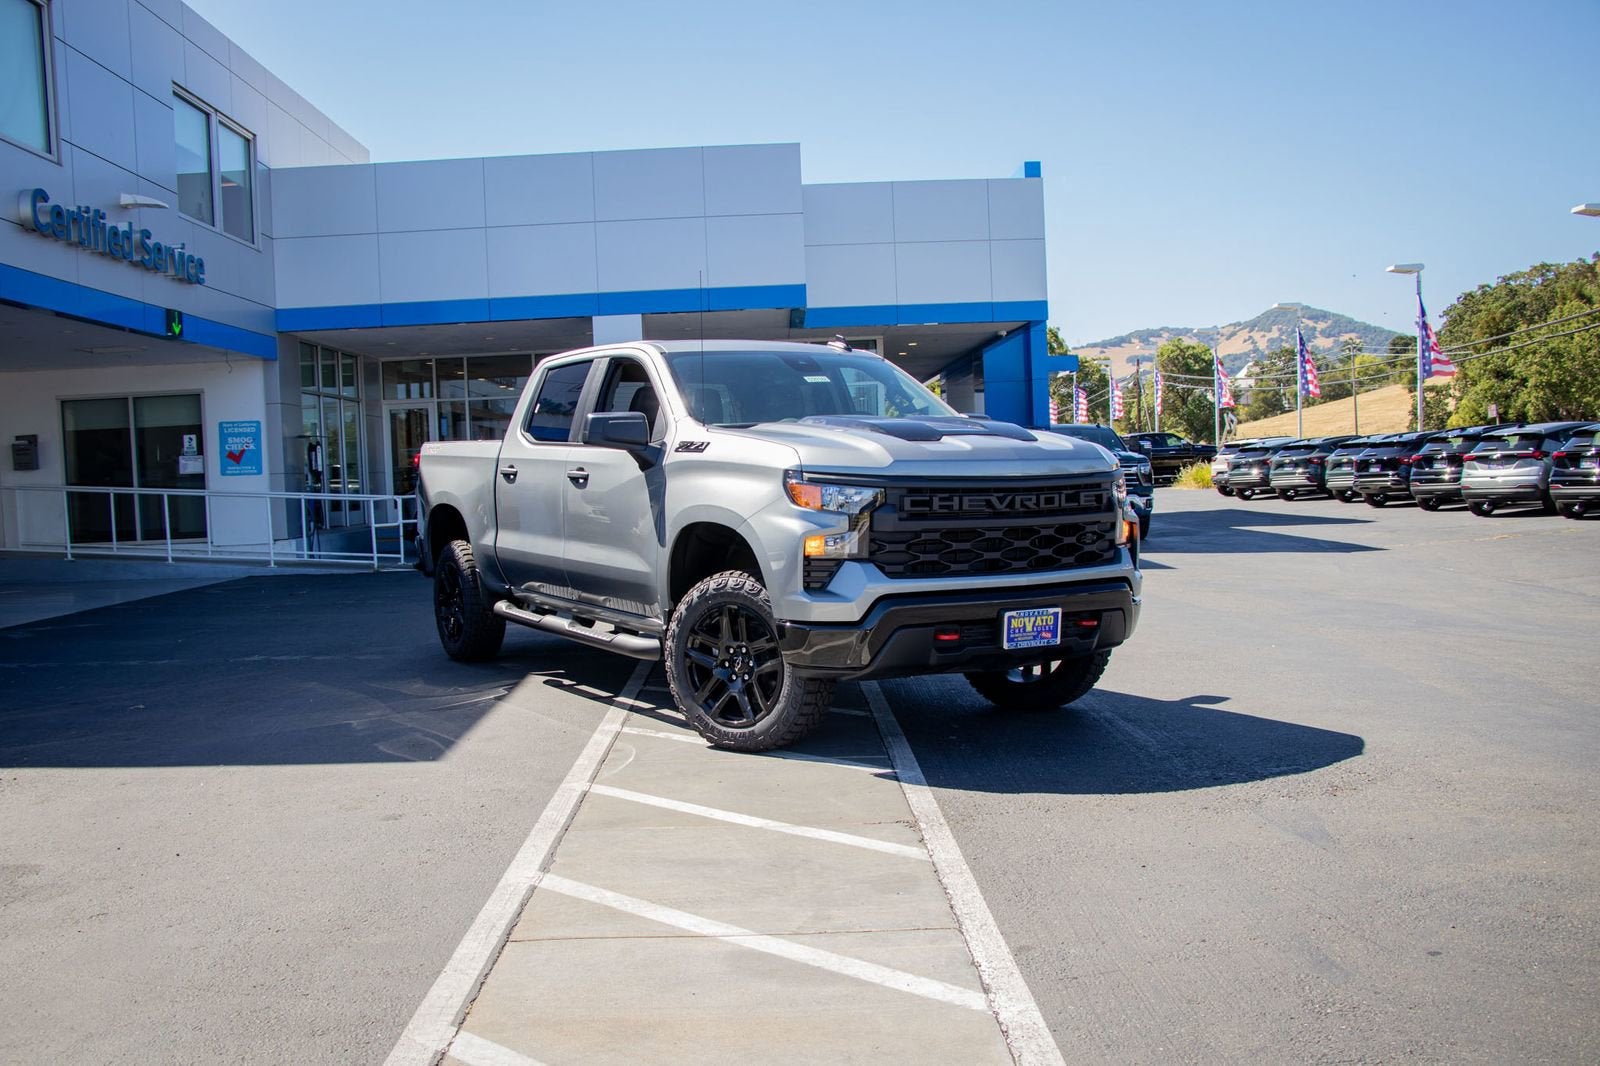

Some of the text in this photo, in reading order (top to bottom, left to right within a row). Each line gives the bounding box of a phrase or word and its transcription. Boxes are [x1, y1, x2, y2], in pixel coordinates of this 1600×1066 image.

[30, 187, 206, 285] Certified Service
[227, 436, 253, 444] SMOG
[903, 490, 1110, 513] CHEVROLET
[1010, 615, 1054, 632] NOVATO
